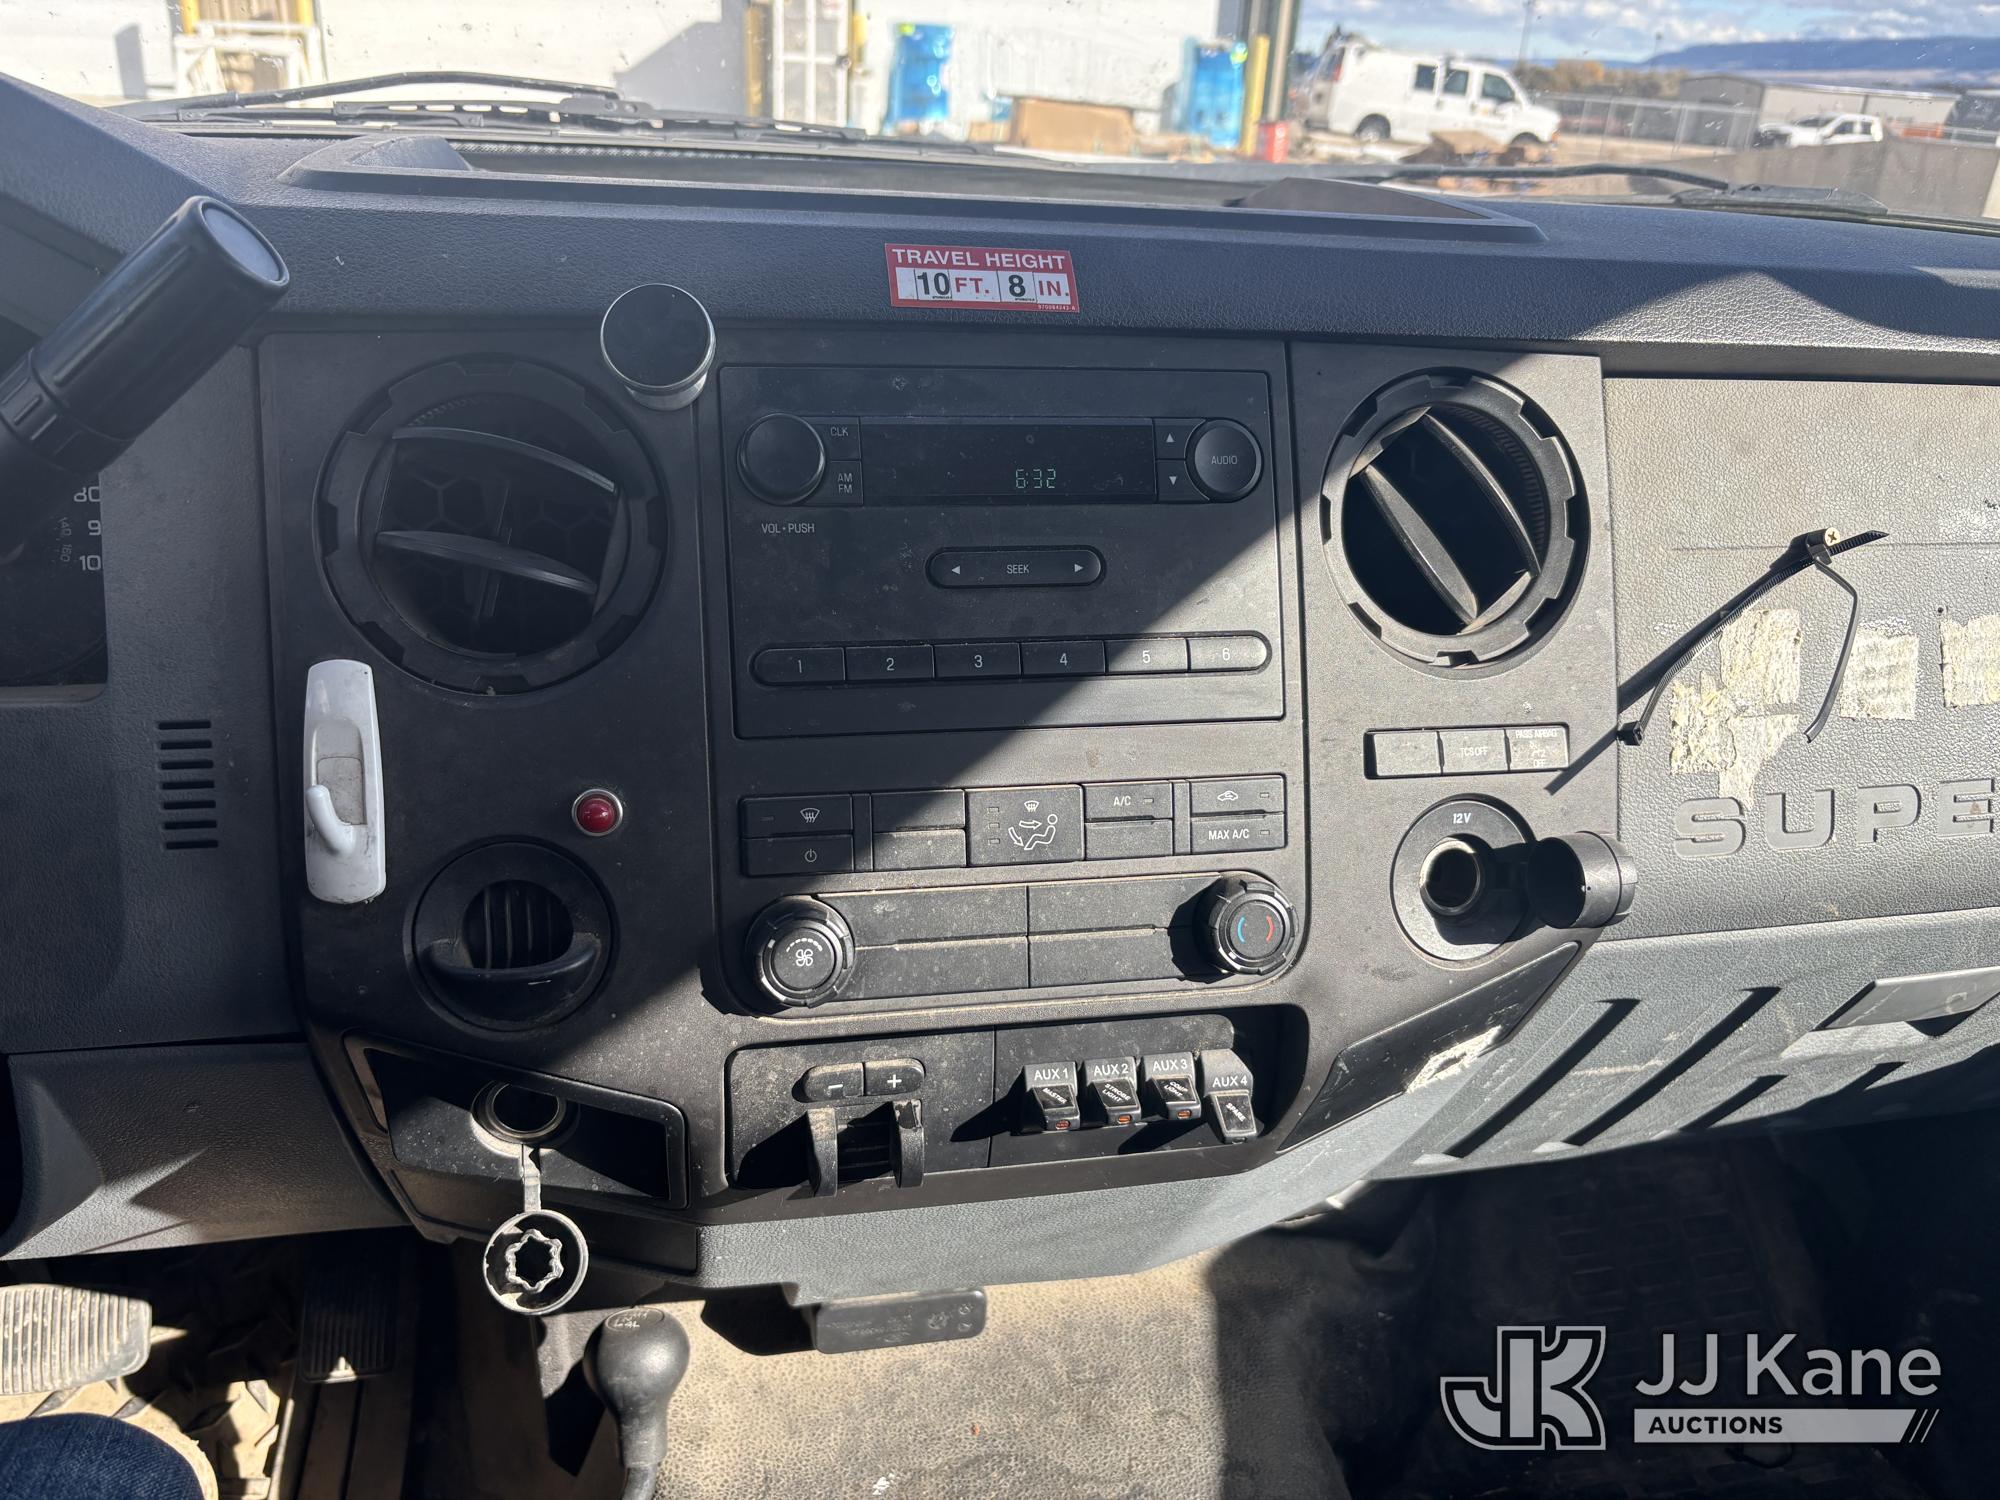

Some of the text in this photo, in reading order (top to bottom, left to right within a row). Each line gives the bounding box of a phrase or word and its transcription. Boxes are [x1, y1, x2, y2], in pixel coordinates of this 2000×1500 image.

[892, 248, 1065, 270] TRAVEL HEIGHT
[917, 271, 1070, 298] 10 FT. 8 IN.
[830, 426, 849, 436] CLK
[1210, 455, 1238, 465] AUDIO
[837, 473, 853, 483] AM
[1015, 468, 1056, 489] 6:32
[838, 484, 853, 494] FM
[761, 523, 815, 533] VOL PUSH
[1006, 564, 1029, 574] SEEK
[974, 654, 983, 668] 3
[1059, 652, 1068, 667] 4
[1142, 649, 1151, 664] 5
[1221, 647, 1231, 662] 6
[886, 657, 895, 672] 2
[1460, 747, 1489, 757] TCS OFF
[1113, 796, 1131, 806] A/C
[1453, 813, 1472, 824] 12V
[1674, 778, 1995, 858] SUPE
[1208, 828, 1250, 840] MAX A/C
[1093, 1063, 1129, 1077] AUX 2
[1152, 1059, 1188, 1072] AUX 3
[1034, 1067, 1069, 1080] AUX 1
[1212, 1075, 1248, 1088] AUX 4
[1042, 1087, 1068, 1104] MASTER
[1102, 1089, 1123, 1102] LIGHT
[1104, 1083, 1132, 1101] STROBE
[1225, 1102, 1246, 1122] SPARE
